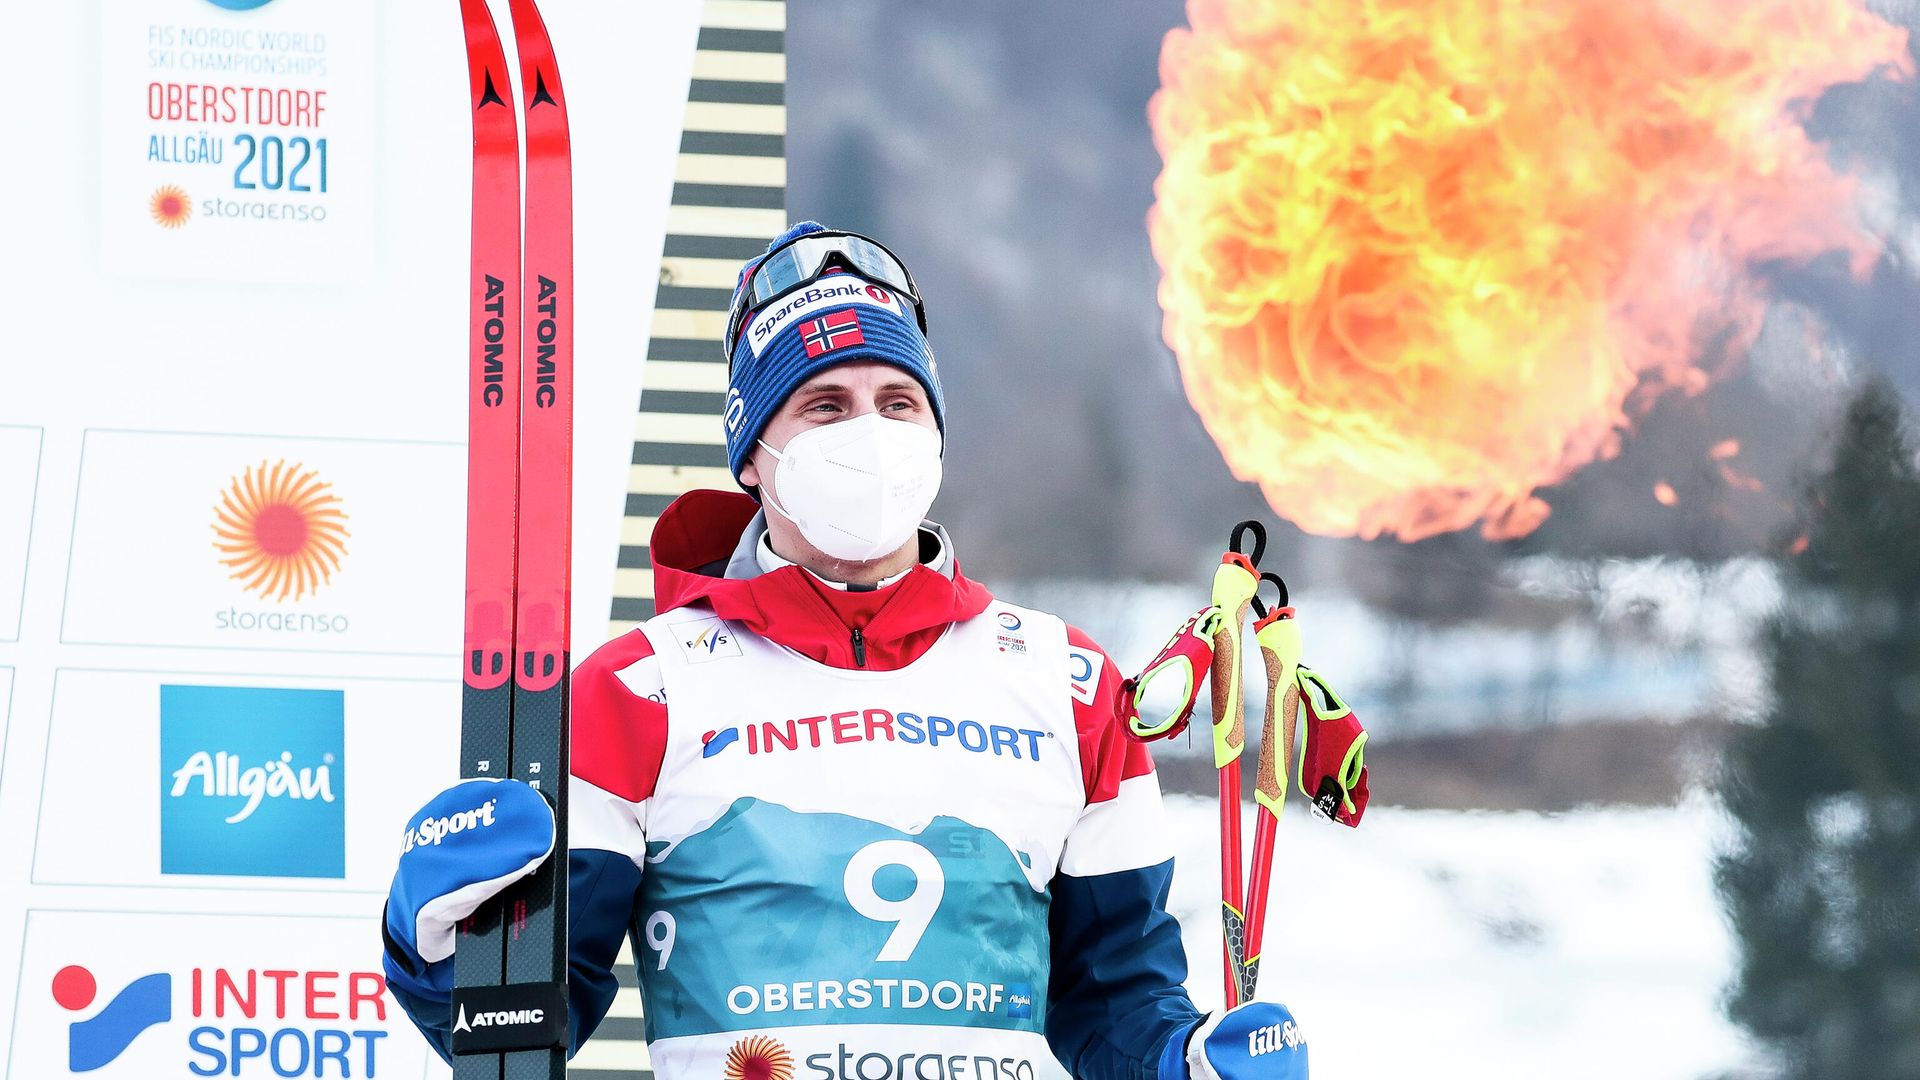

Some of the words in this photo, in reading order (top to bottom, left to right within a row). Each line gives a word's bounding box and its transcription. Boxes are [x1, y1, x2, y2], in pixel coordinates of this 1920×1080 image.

[147, 24, 175, 47] FIS
[180, 27, 254, 51] NORDIC
[259, 31, 327, 54] WORLD
[147, 48, 174, 70] SKI
[180, 50, 327, 77] CHAMPIONSHIPS
[148, 82, 327, 128] OBERSTDORF
[148, 131, 223, 164] ALLGÄU
[233, 134, 327, 193] 2021
[202, 197, 327, 222] storaenso
[754, 284, 862, 342] SpareBank
[483, 274, 504, 408] ATOMIC
[536, 274, 557, 408] ATOMIC
[216, 607, 349, 633] storaenso
[686, 635, 728, 649] FIS
[747, 709, 1046, 762] INTERSPORT
[170, 752, 335, 824] Allgäu
[843, 839, 946, 963] 9
[645, 910, 676, 971] 9
[193, 967, 387, 1021] INTER
[471, 1009, 544, 1027] ATOMIC
[726, 978, 1004, 1015] OBERSTDORF
[188, 1026, 389, 1079] SPORT
[806, 1043, 1034, 1080] storaenso
